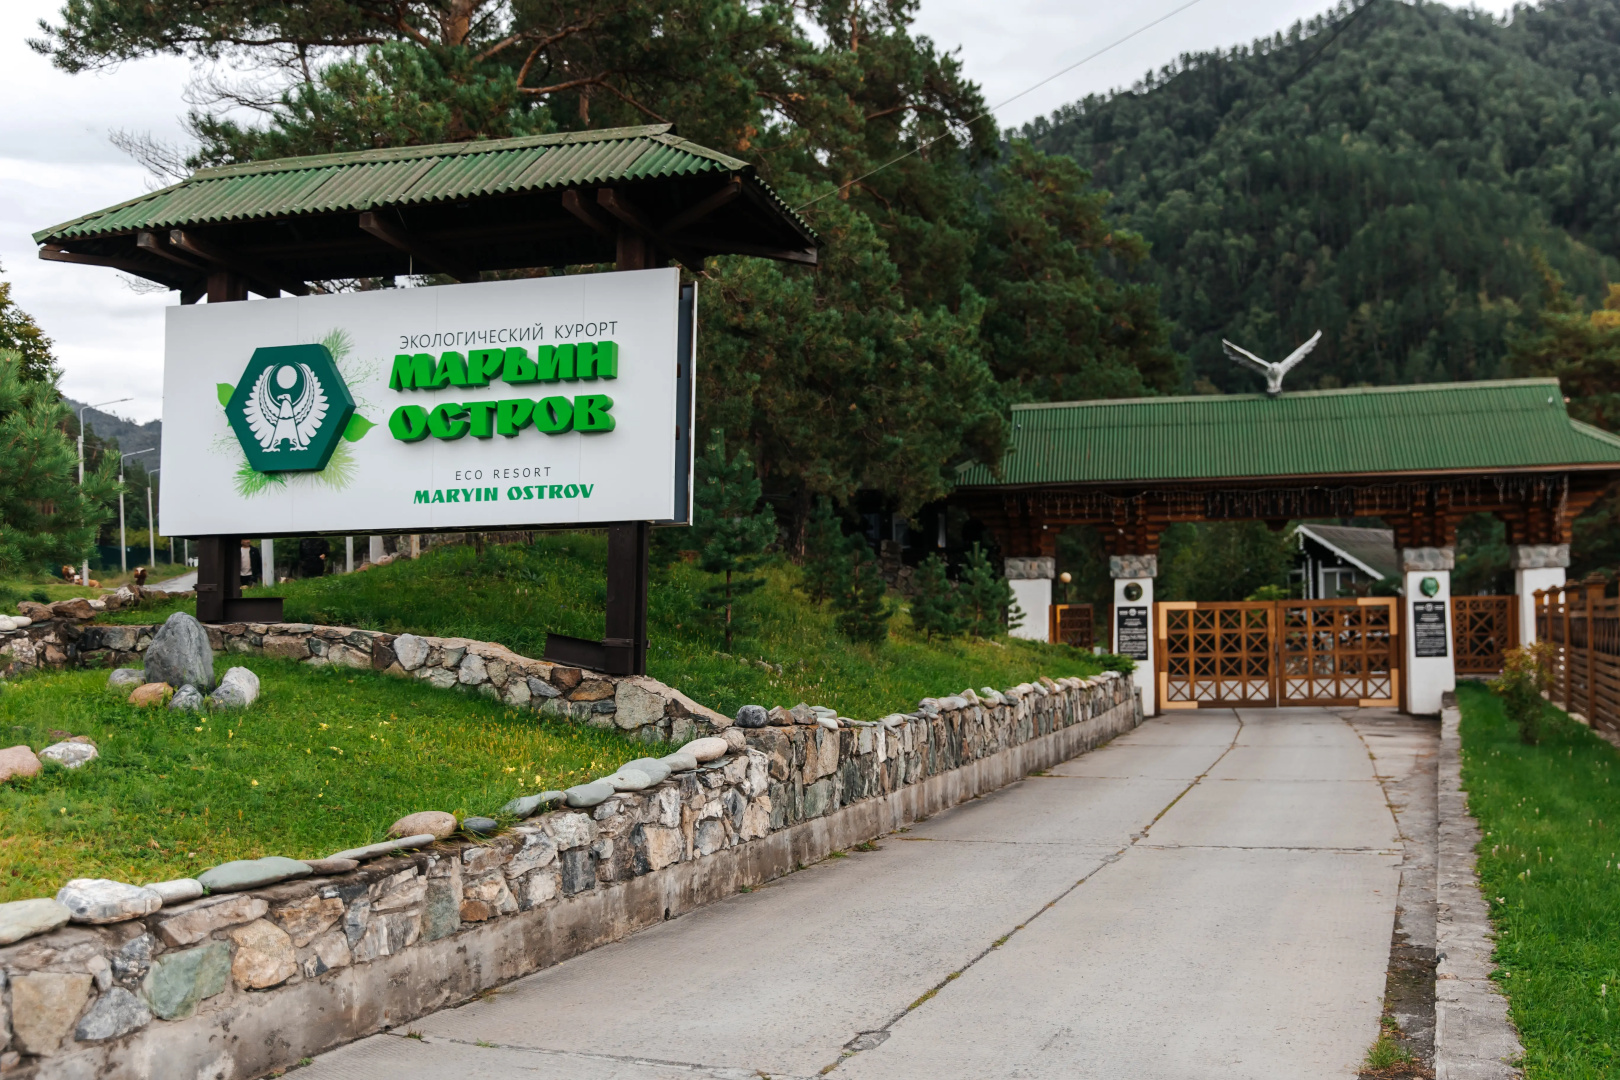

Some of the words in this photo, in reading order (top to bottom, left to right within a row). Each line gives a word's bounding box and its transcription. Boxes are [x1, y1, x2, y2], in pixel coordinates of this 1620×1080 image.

[399, 323, 544, 350] ЭКОЛОГИЧЕСКИЙ
[554, 321, 618, 340] КУРОРТ
[388, 341, 618, 392] МАРЬИН
[388, 394, 616, 442] ОСТРОВ
[455, 469, 482, 480] ECO
[493, 467, 552, 479] RESORT
[413, 486, 499, 505] MARYIN
[507, 483, 595, 501] OSTROV
